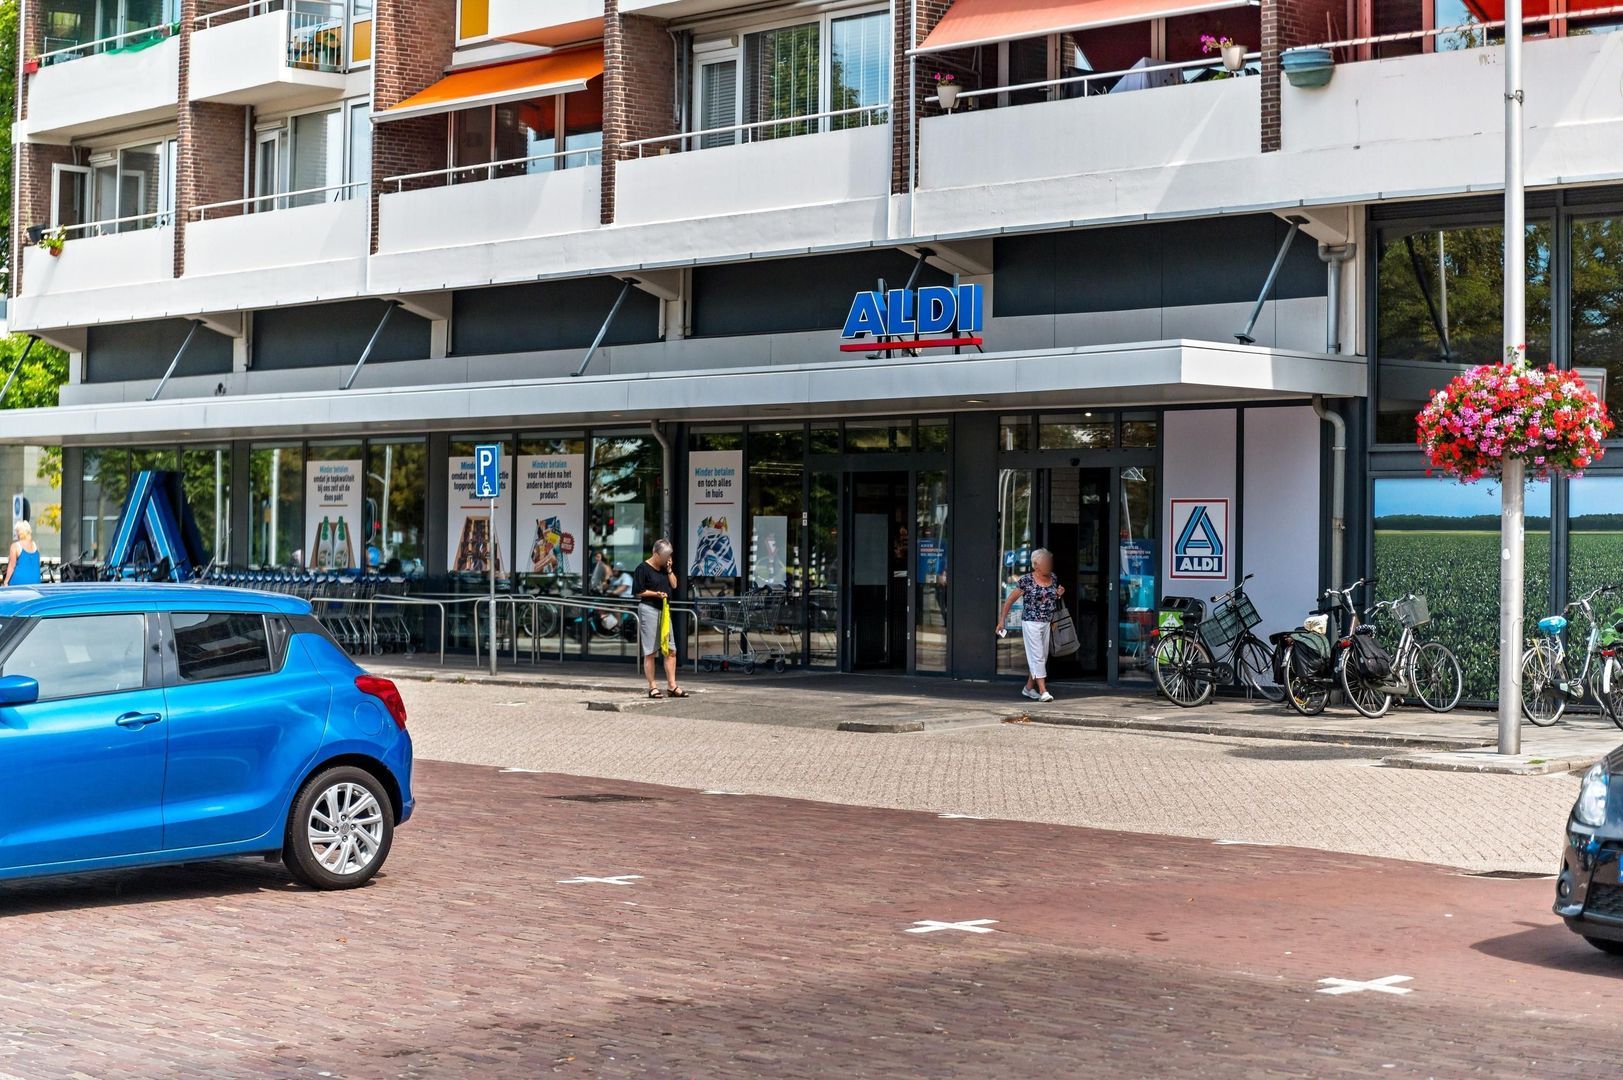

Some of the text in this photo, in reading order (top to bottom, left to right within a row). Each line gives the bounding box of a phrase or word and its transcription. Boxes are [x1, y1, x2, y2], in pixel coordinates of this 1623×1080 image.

[840, 283, 980, 338] ALDI
[480, 450, 492, 476] P
[531, 460, 567, 469] Minder betalen
[451, 472, 468, 480] omdat
[538, 470, 547, 478] het
[564, 470, 572, 478] het
[694, 466, 735, 477] Minder betalen
[313, 475, 326, 483] omdat
[331, 474, 355, 483] topkwaliteit
[697, 478, 732, 487] en toch alles
[526, 480, 573, 490] andere best geteste
[539, 491, 559, 501] product
[706, 489, 724, 498] in huis
[1180, 557, 1219, 571] ALDI
